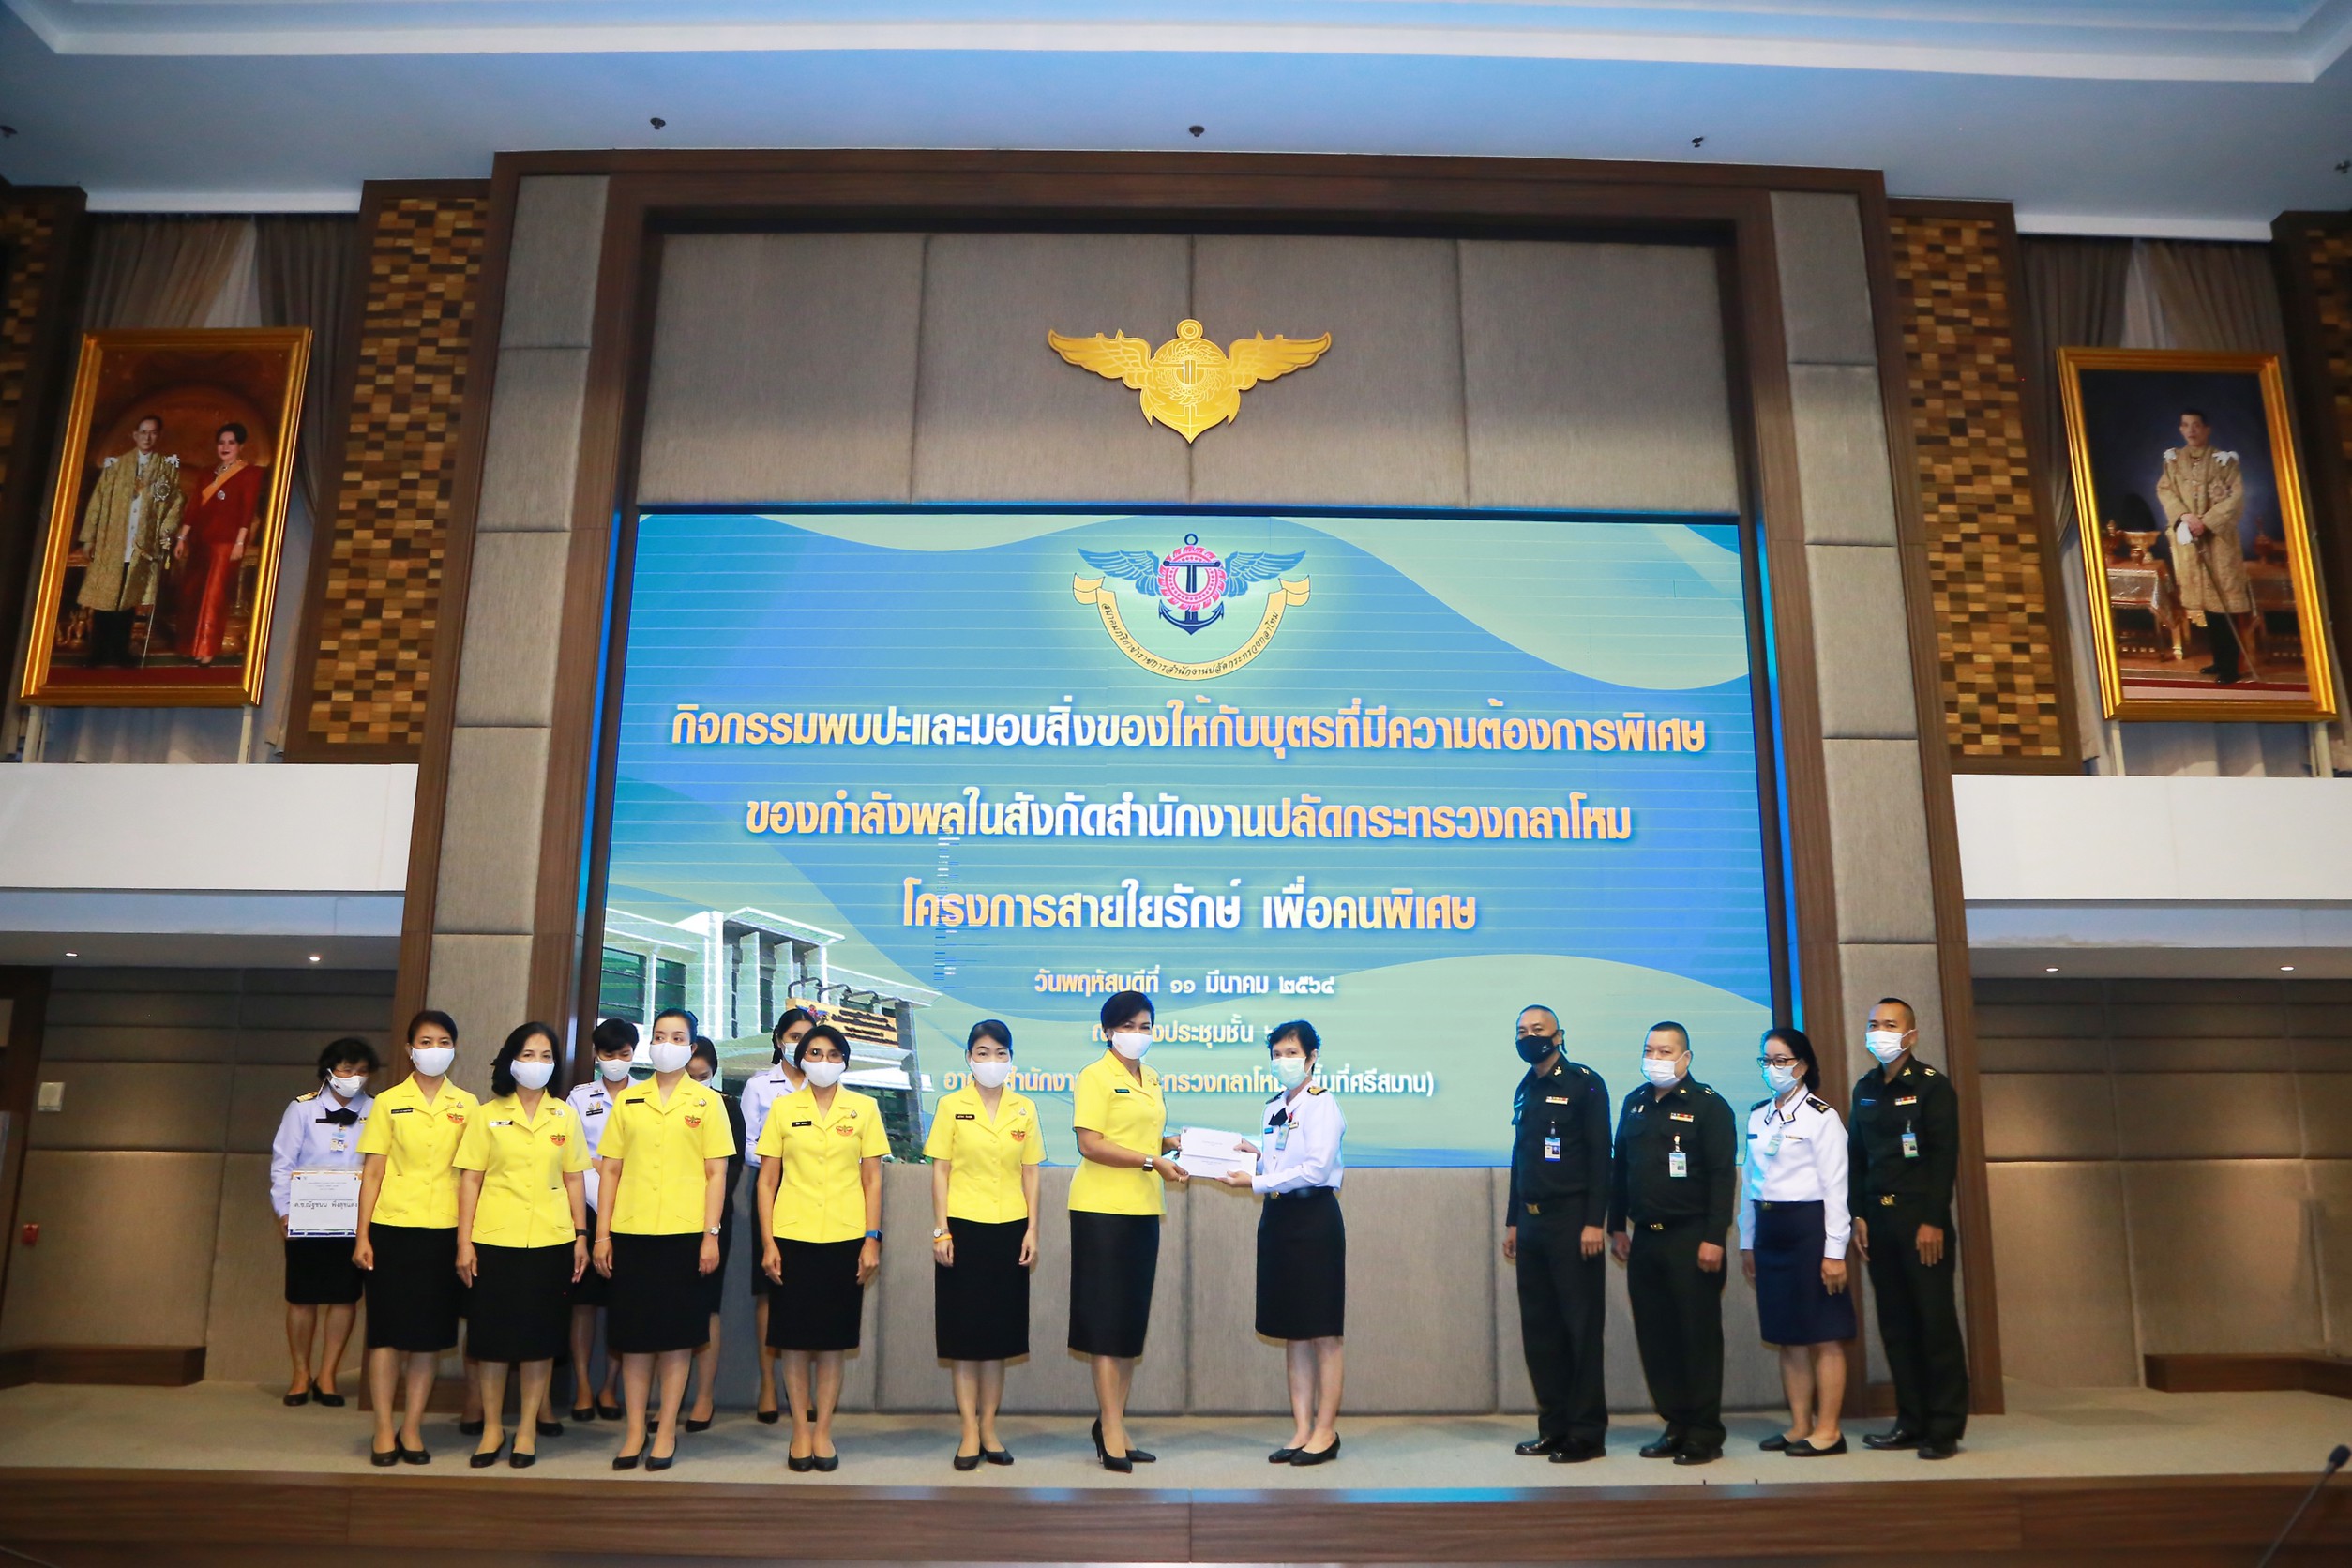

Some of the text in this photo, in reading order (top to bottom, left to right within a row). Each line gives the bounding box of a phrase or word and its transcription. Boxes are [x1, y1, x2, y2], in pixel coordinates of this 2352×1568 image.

[672, 695, 1706, 759] กิจกรรมพบปะและมอบสิ่งของให้กับบุตรที่มีความต้องการพิเศษ
[746, 786, 1632, 840] ของกำลังพลในสังกัดสำนักงานปลัดกระทรวงกลาโหม
[903, 875, 1476, 930] โครงการสายใยรักษ์ เพื่อคนพิเศษ
[1034, 964, 1335, 997] วันพฤหัสบดีที่ ๑๑ มีนาคม ๒๕๖๔
